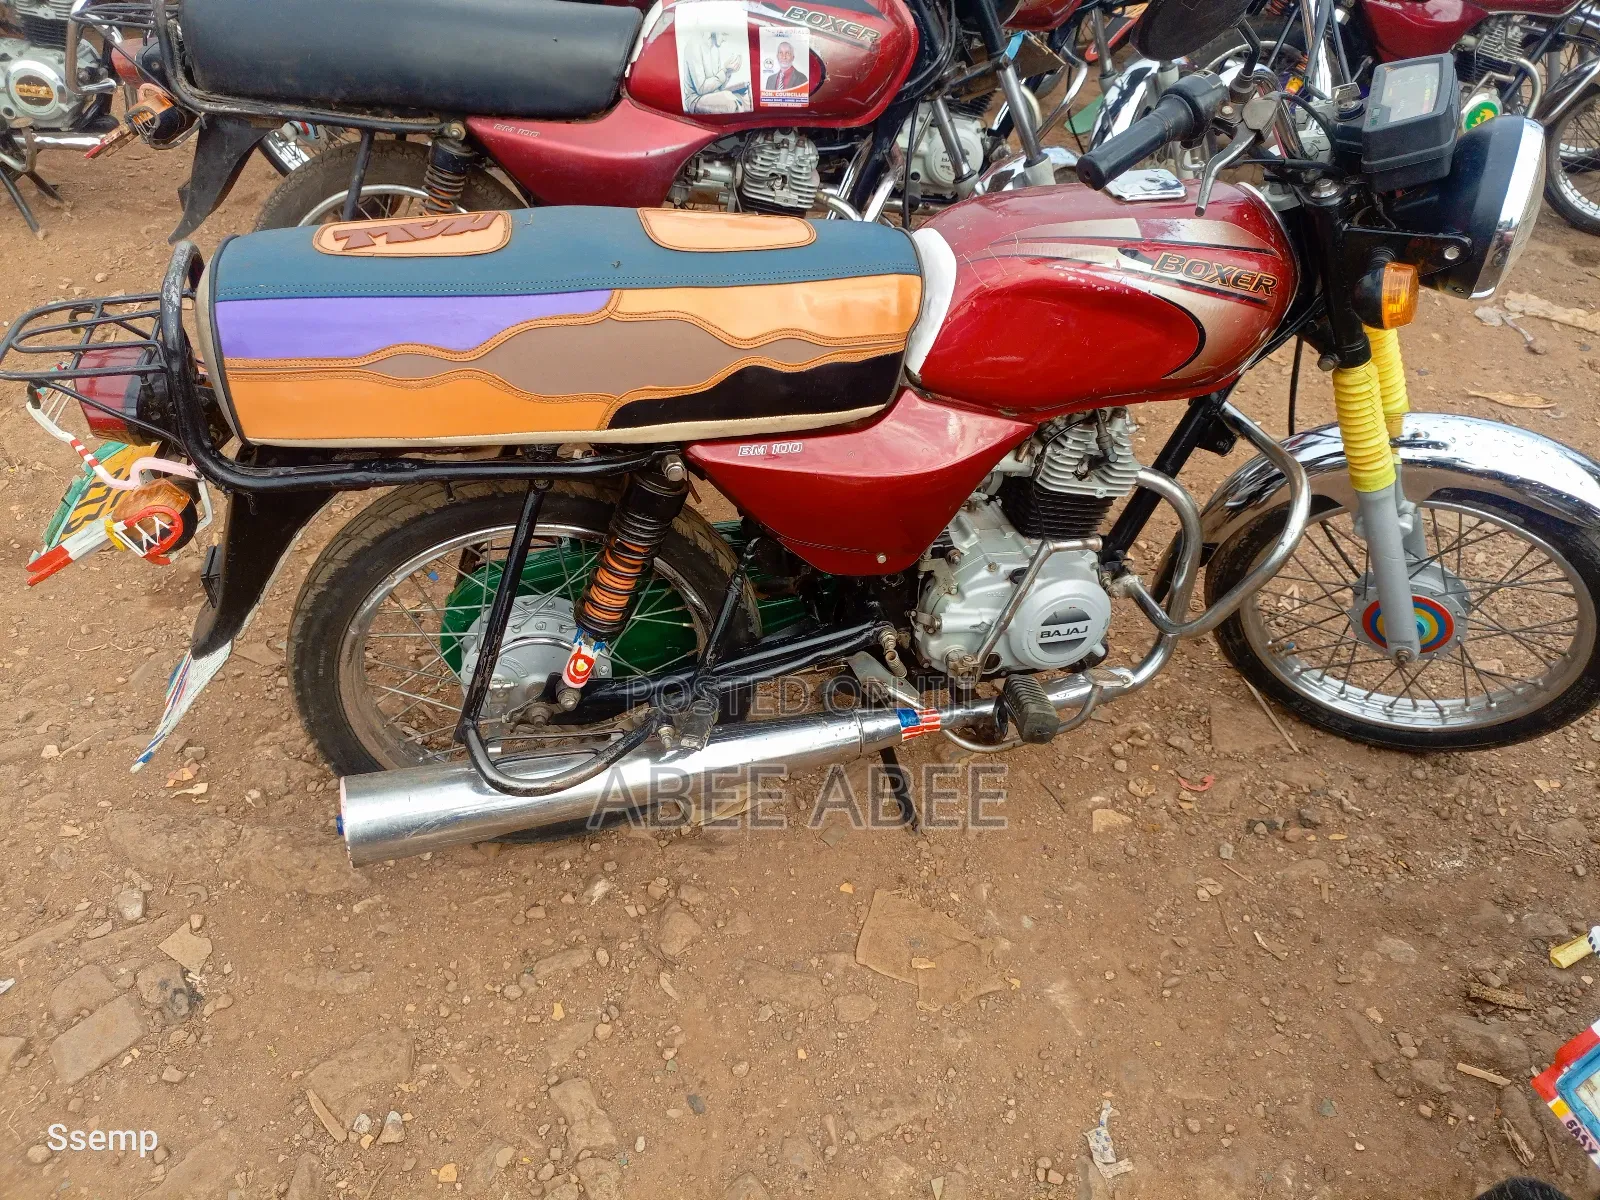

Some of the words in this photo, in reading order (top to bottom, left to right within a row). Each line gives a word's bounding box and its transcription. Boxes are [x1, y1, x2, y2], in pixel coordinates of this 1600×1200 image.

[783, 5, 882, 43] BOXER
[1151, 251, 1279, 296] BOXER
[738, 445, 767, 457] BM
[771, 442, 803, 455] 100
[1040, 625, 1089, 639] BAJAJ
